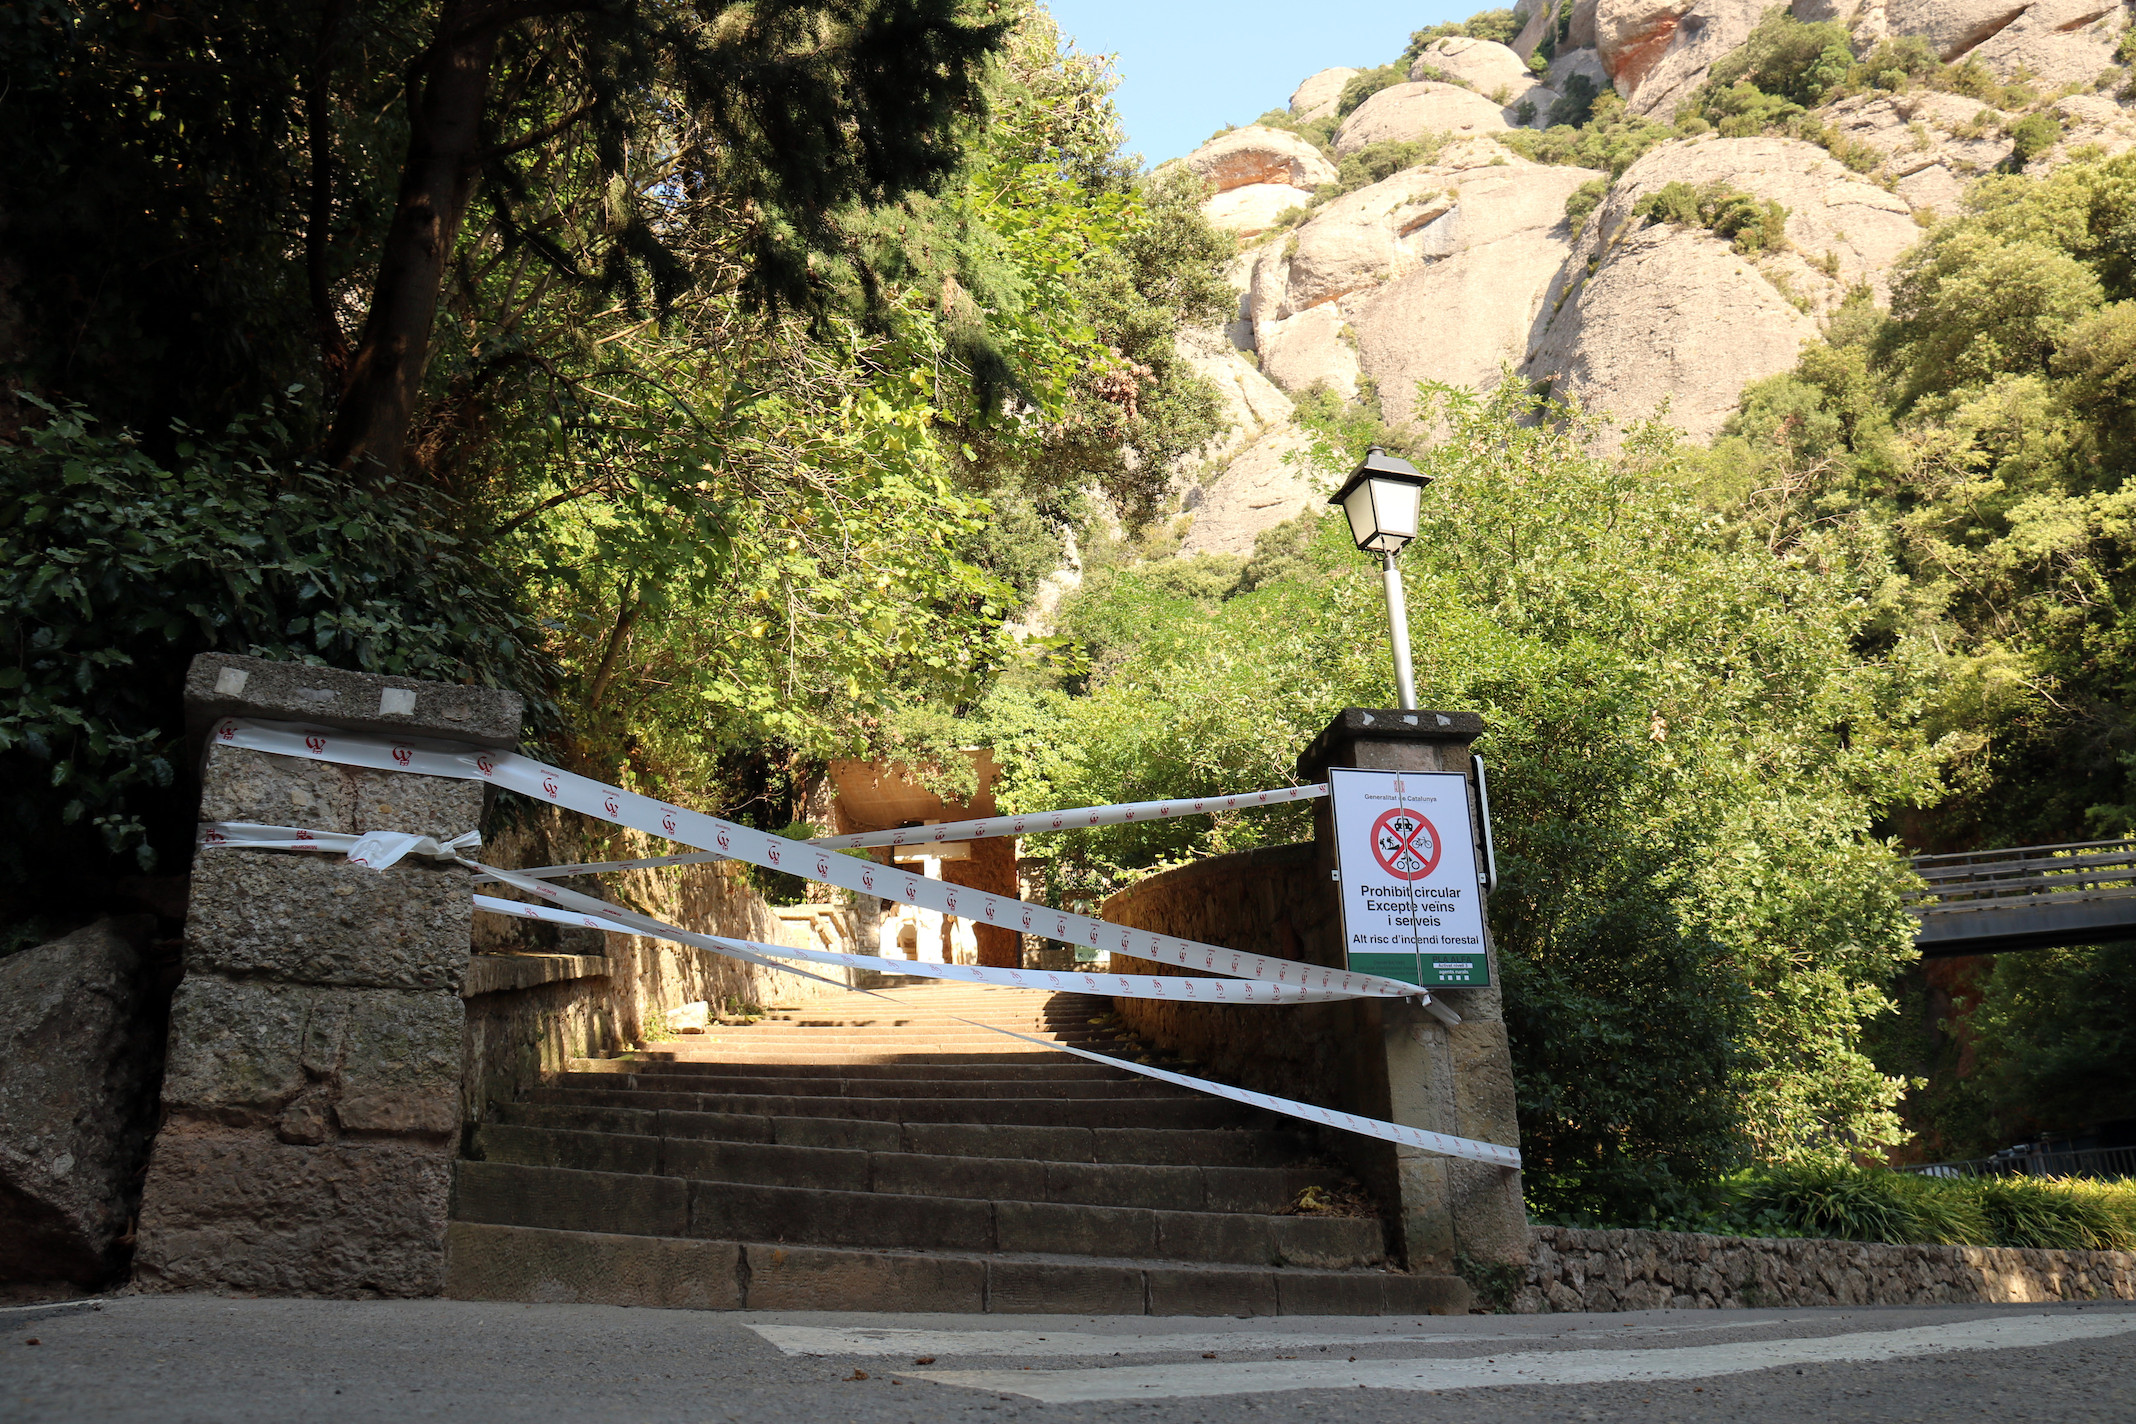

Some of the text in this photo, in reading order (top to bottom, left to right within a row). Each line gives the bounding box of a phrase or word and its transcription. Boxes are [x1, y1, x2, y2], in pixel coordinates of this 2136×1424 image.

[1364, 793, 1397, 801] Generalitat
[1407, 795, 1438, 803] Catalunya
[1361, 885, 1461, 898] Prohibit circular
[1367, 900, 1455, 914] Excepte veïns
[1395, 916, 1441, 926] serveis
[1353, 934, 1480, 945] Alt risc d'incendi forestal
